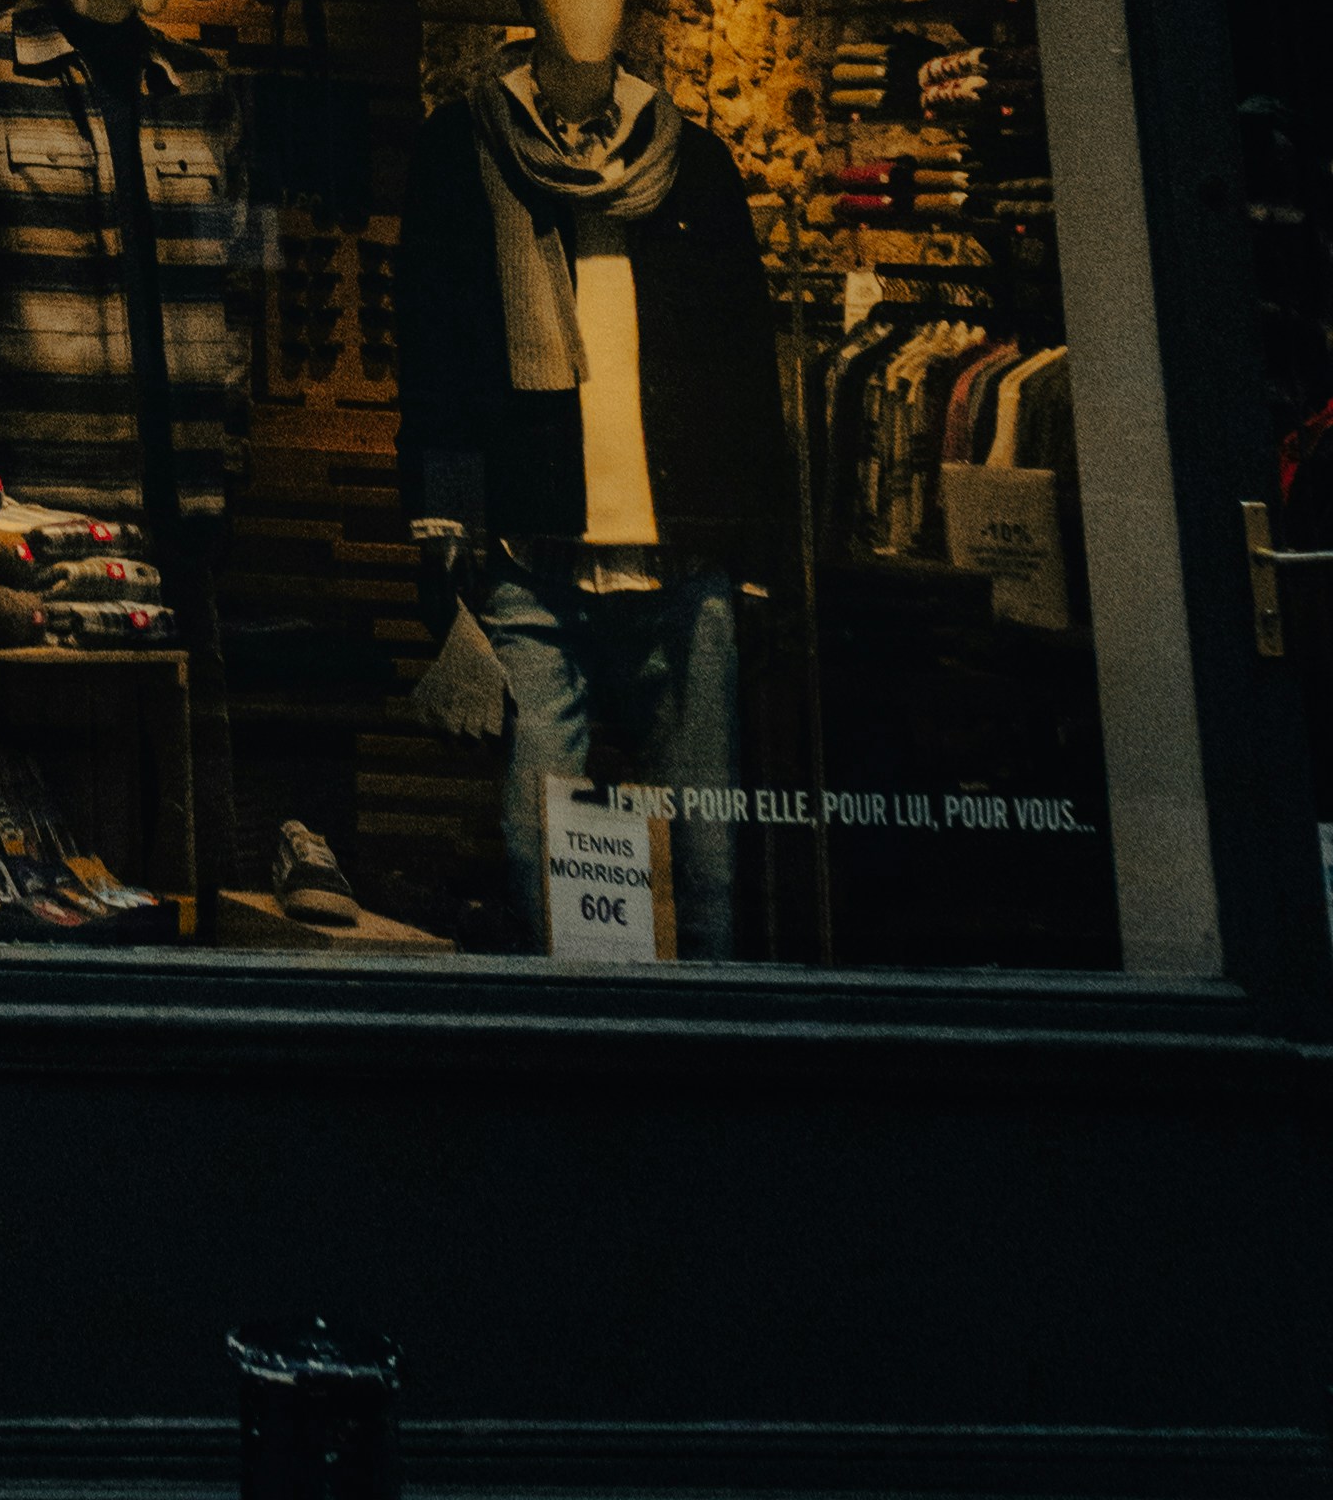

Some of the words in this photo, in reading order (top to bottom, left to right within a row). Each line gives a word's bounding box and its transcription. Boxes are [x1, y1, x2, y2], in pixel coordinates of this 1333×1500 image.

[683, 786, 751, 823] POUR
[756, 788, 818, 829] ELLE,
[821, 787, 889, 827] POUR
[894, 792, 941, 833] LUI,
[943, 794, 1012, 831] POUR
[565, 830, 635, 858] TENNIS
[549, 857, 653, 889] MORRISON
[580, 893, 628, 926] 60€
